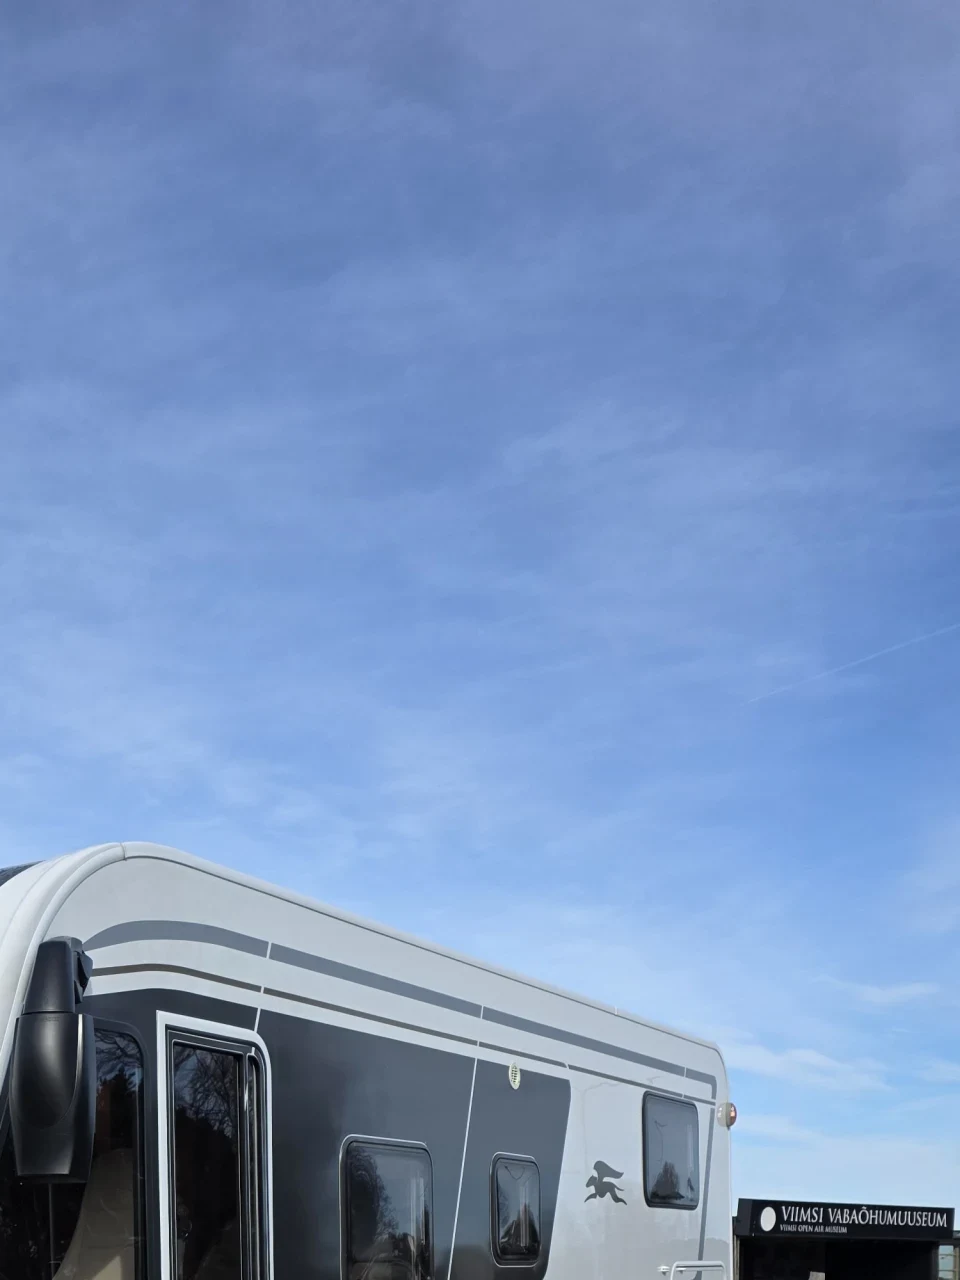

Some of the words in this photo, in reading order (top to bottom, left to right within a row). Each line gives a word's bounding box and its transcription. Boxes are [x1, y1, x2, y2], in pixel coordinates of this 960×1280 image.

[781, 1206, 824, 1223] VIIMSI
[827, 1206, 947, 1228] VABAÕHUMUUSEUM
[780, 1224, 797, 1232] VIIMSI
[798, 1224, 814, 1232] OPEN
[814, 1225, 825, 1233] AIR
[825, 1225, 848, 1234] MUSEUM
